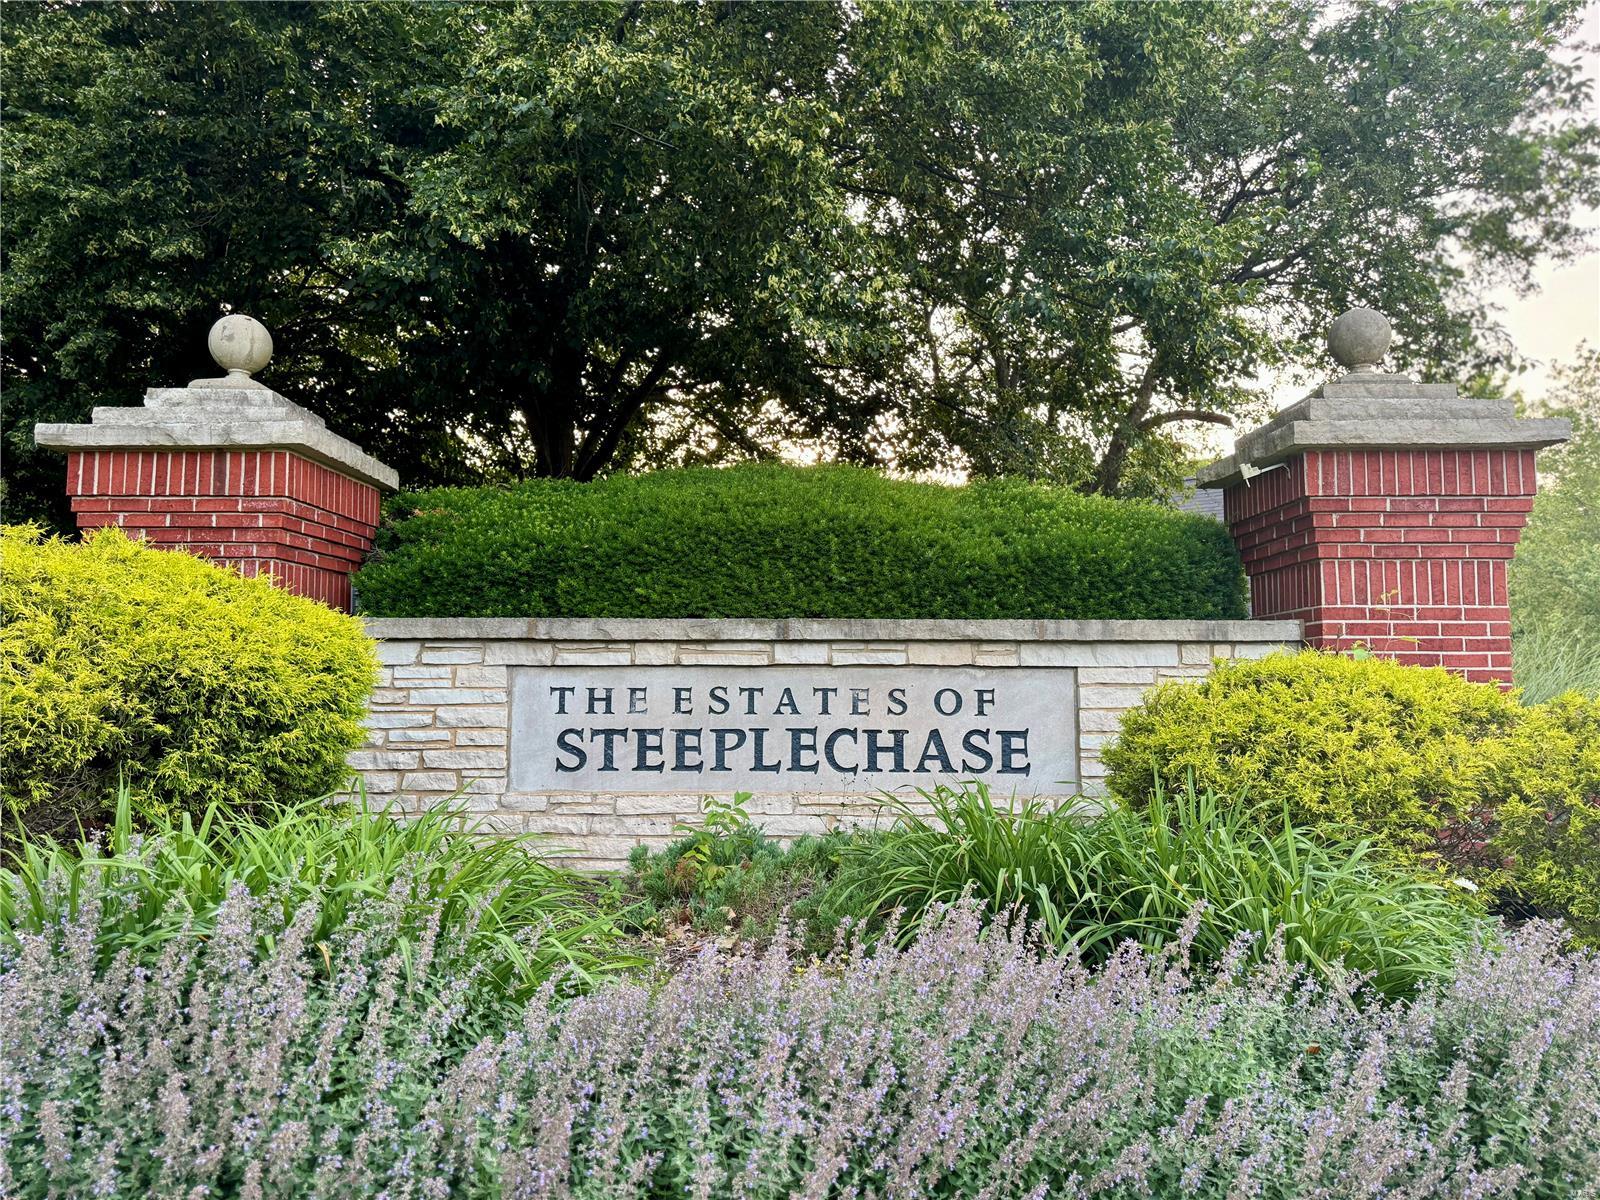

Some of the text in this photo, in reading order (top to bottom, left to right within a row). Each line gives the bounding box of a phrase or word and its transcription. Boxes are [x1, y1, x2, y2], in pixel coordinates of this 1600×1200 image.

[549, 687, 996, 716] THE ESTATES OF
[555, 726, 1031, 778] STEEPLECHASE
